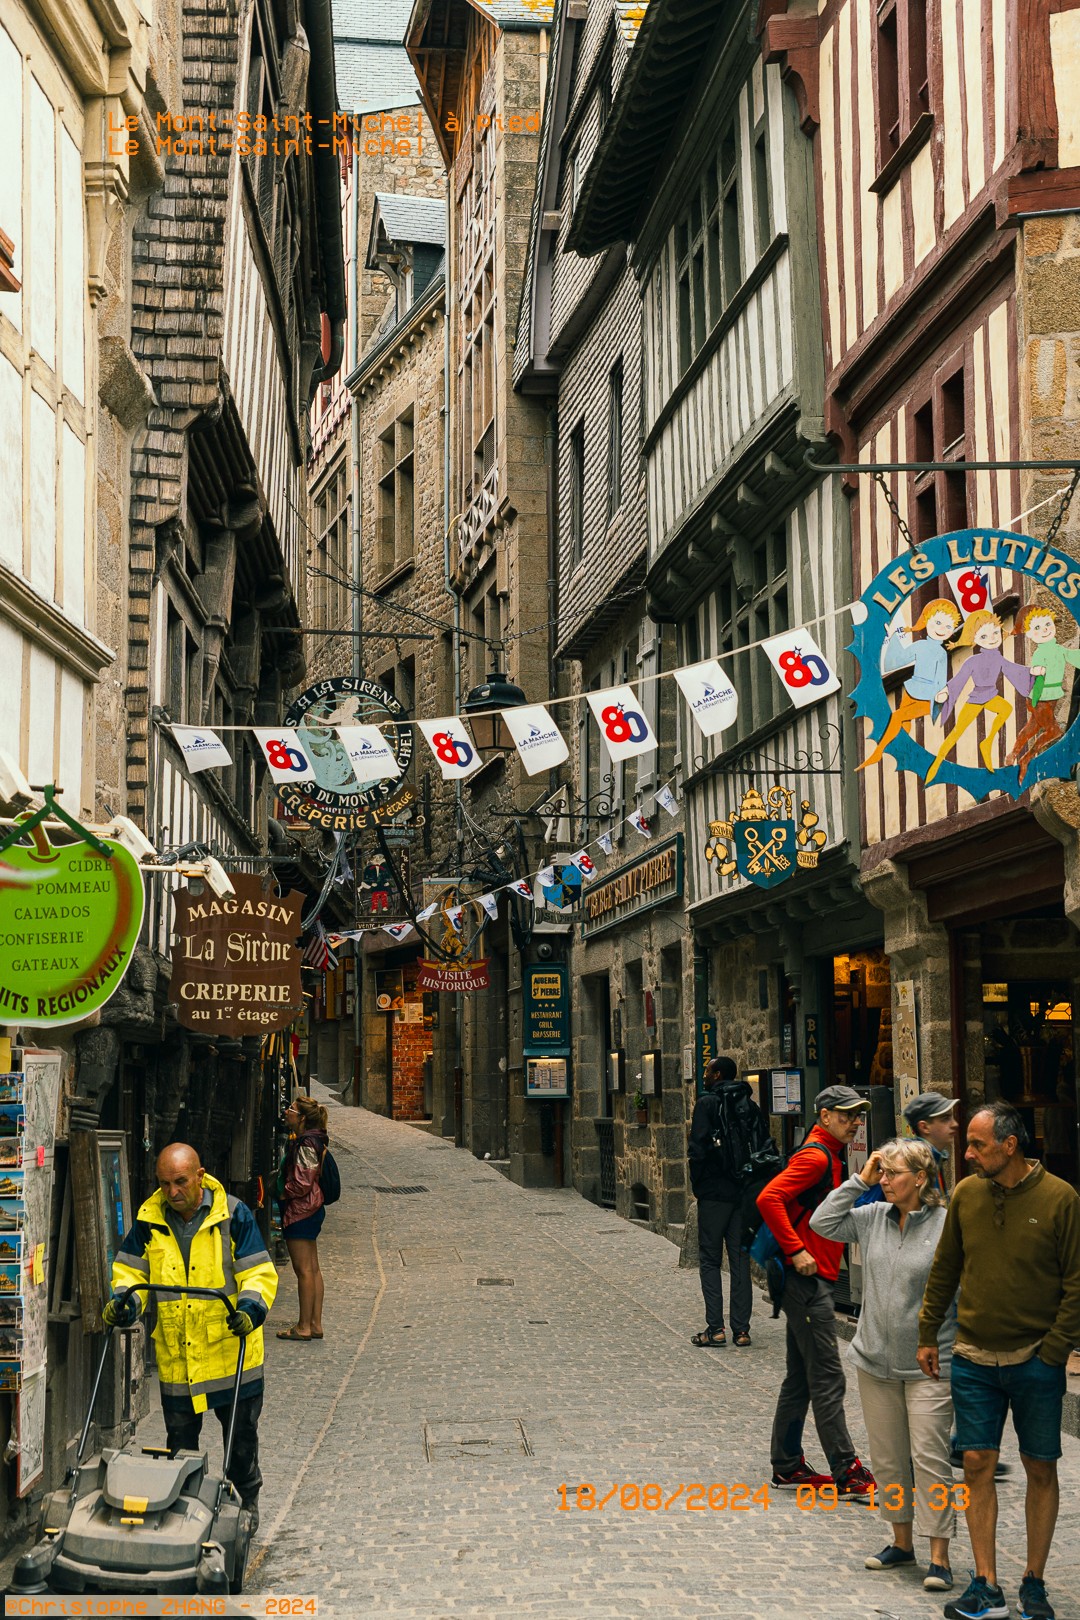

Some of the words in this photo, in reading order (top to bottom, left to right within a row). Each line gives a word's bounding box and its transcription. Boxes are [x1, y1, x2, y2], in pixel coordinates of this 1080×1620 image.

[872, 552, 936, 615] LES
[946, 534, 1080, 600] LUTINS
[778, 650, 830, 688] 80
[312, 680, 335, 696] LA
[341, 678, 402, 714] SIRENE
[692, 699, 703, 709] LA
[702, 687, 734, 705] MANCHE
[601, 705, 649, 743] 80
[518, 738, 528, 748] LA
[528, 730, 559, 744] MANCHE
[265, 738, 309, 773] 80
[359, 748, 389, 756] MANCHE
[432, 731, 474, 768] 80
[315, 789, 335, 805] DU
[338, 788, 378, 807] MONT
[68, 859, 112, 873] CIDRE
[641, 849, 675, 891] PIERRE
[36, 880, 112, 896] POMMEAU
[14, 905, 91, 921] CALVADOS
[187, 898, 295, 926] MAGASIN
[182, 934, 216, 962] La
[223, 931, 292, 969] Sirène
[11, 957, 80, 972] GATEAUX
[37, 943, 128, 1017] REGIONAUX
[421, 976, 488, 992] HISTORIQUE
[436, 970, 473, 980] VISITE
[533, 976, 559, 985] AUBERGE
[180, 981, 291, 1003] CREPERIE
[540, 988, 561, 996] PIERRE
[191, 1010, 211, 1020] au
[237, 1007, 280, 1025] étage
[530, 1011, 563, 1019] RESTAURANT
[538, 1021, 554, 1029] GRILL
[532, 1030, 561, 1039] BRASSERIE
[806, 1018, 818, 1060] BAR
